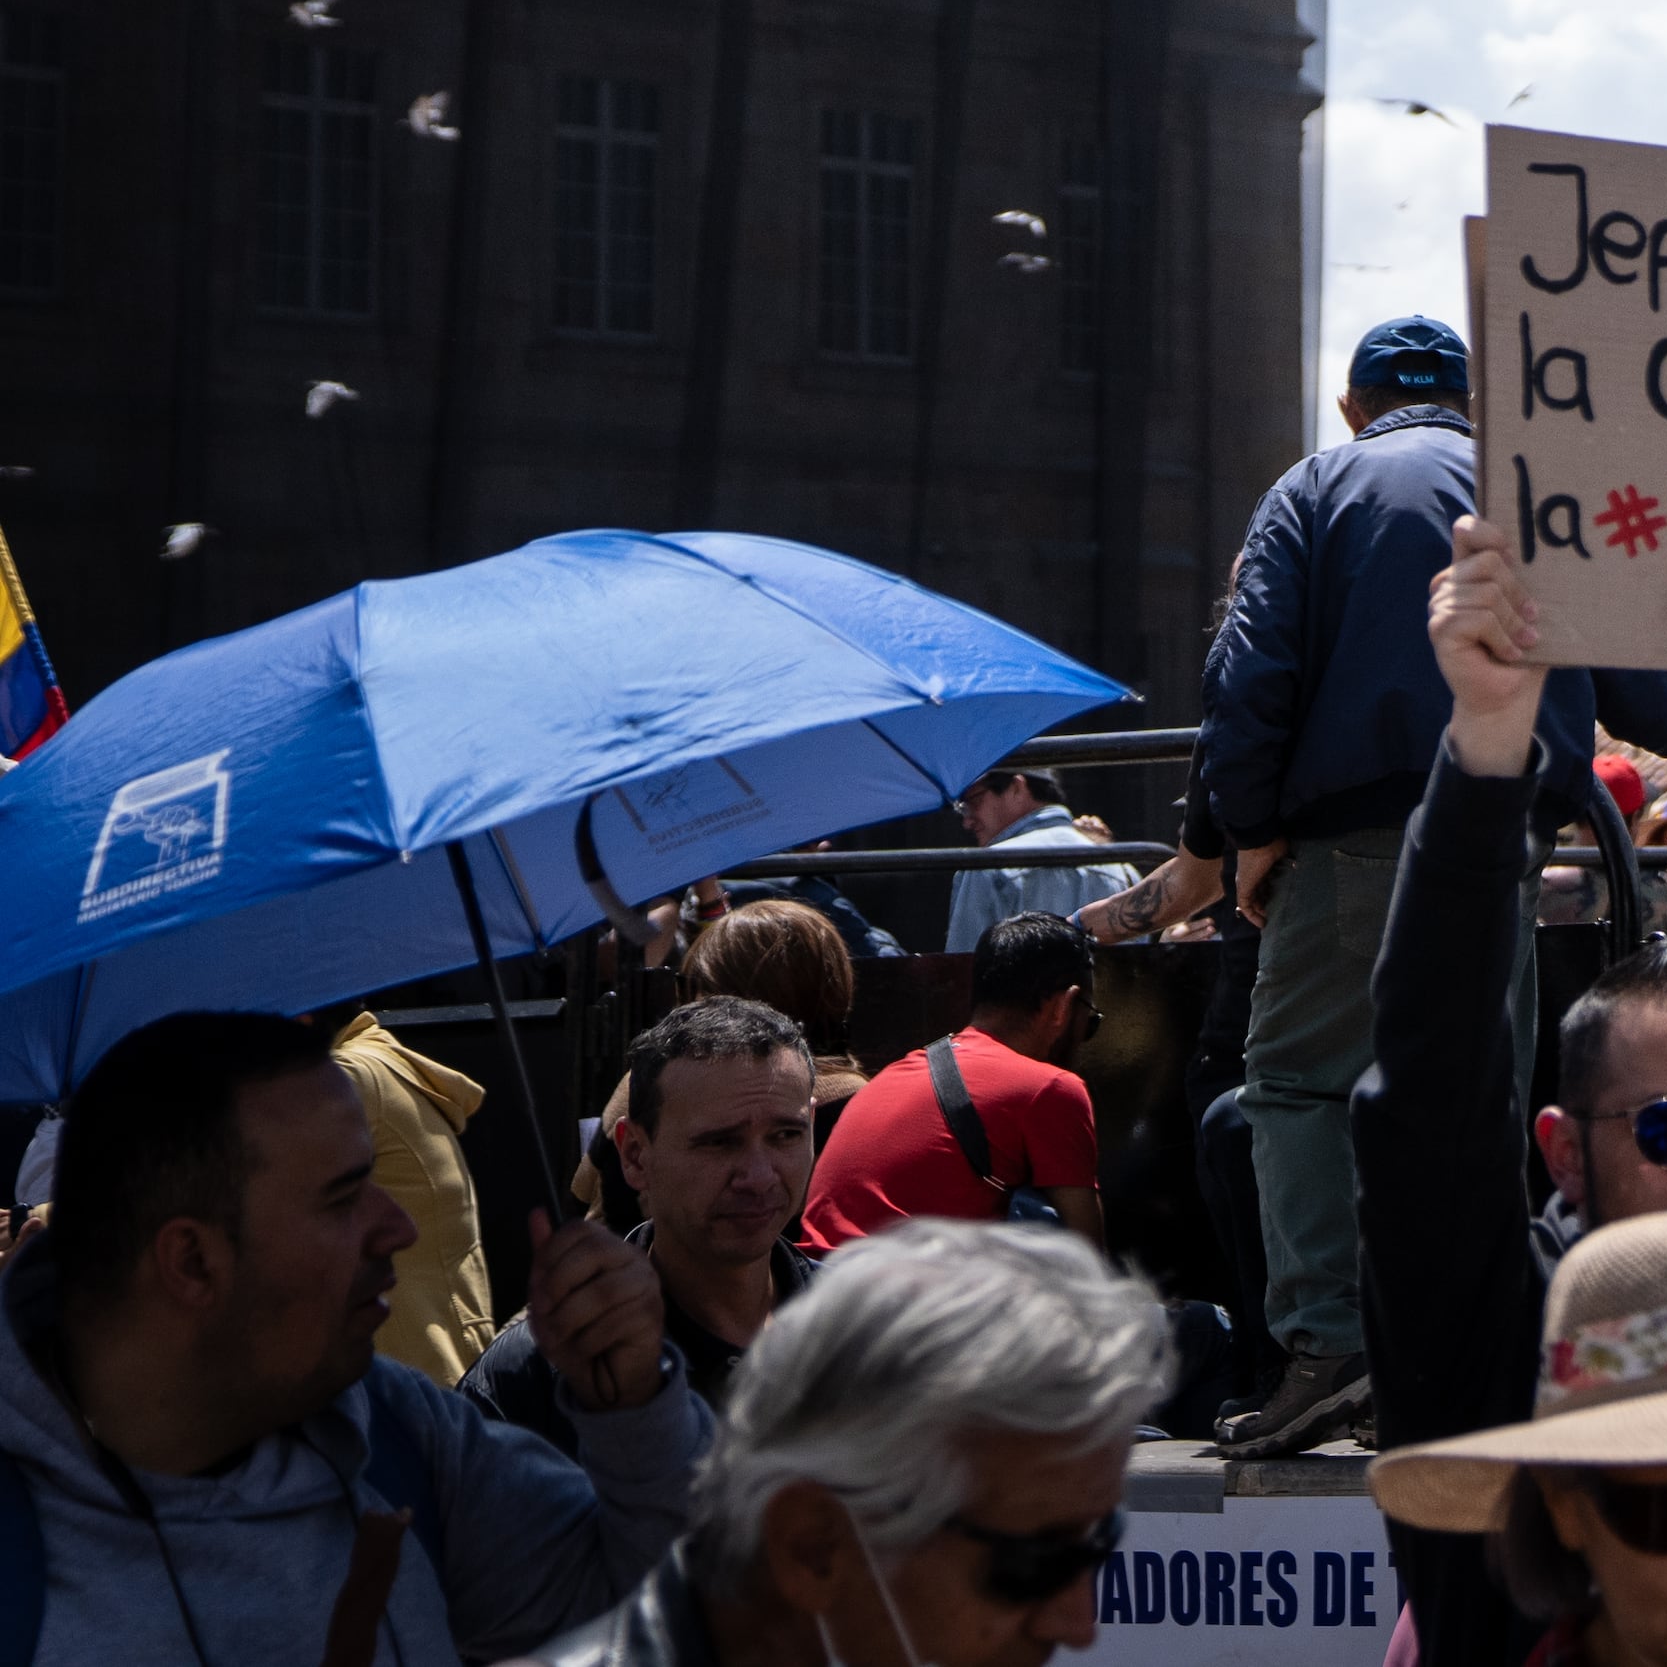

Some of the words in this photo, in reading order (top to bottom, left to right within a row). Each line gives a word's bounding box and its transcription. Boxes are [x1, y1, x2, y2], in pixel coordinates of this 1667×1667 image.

[1521, 310, 1594, 422] la
[1512, 454, 1591, 564] la
[79, 852, 222, 912] SUBDIRECTIVA
[1313, 1551, 1377, 1627] DE
